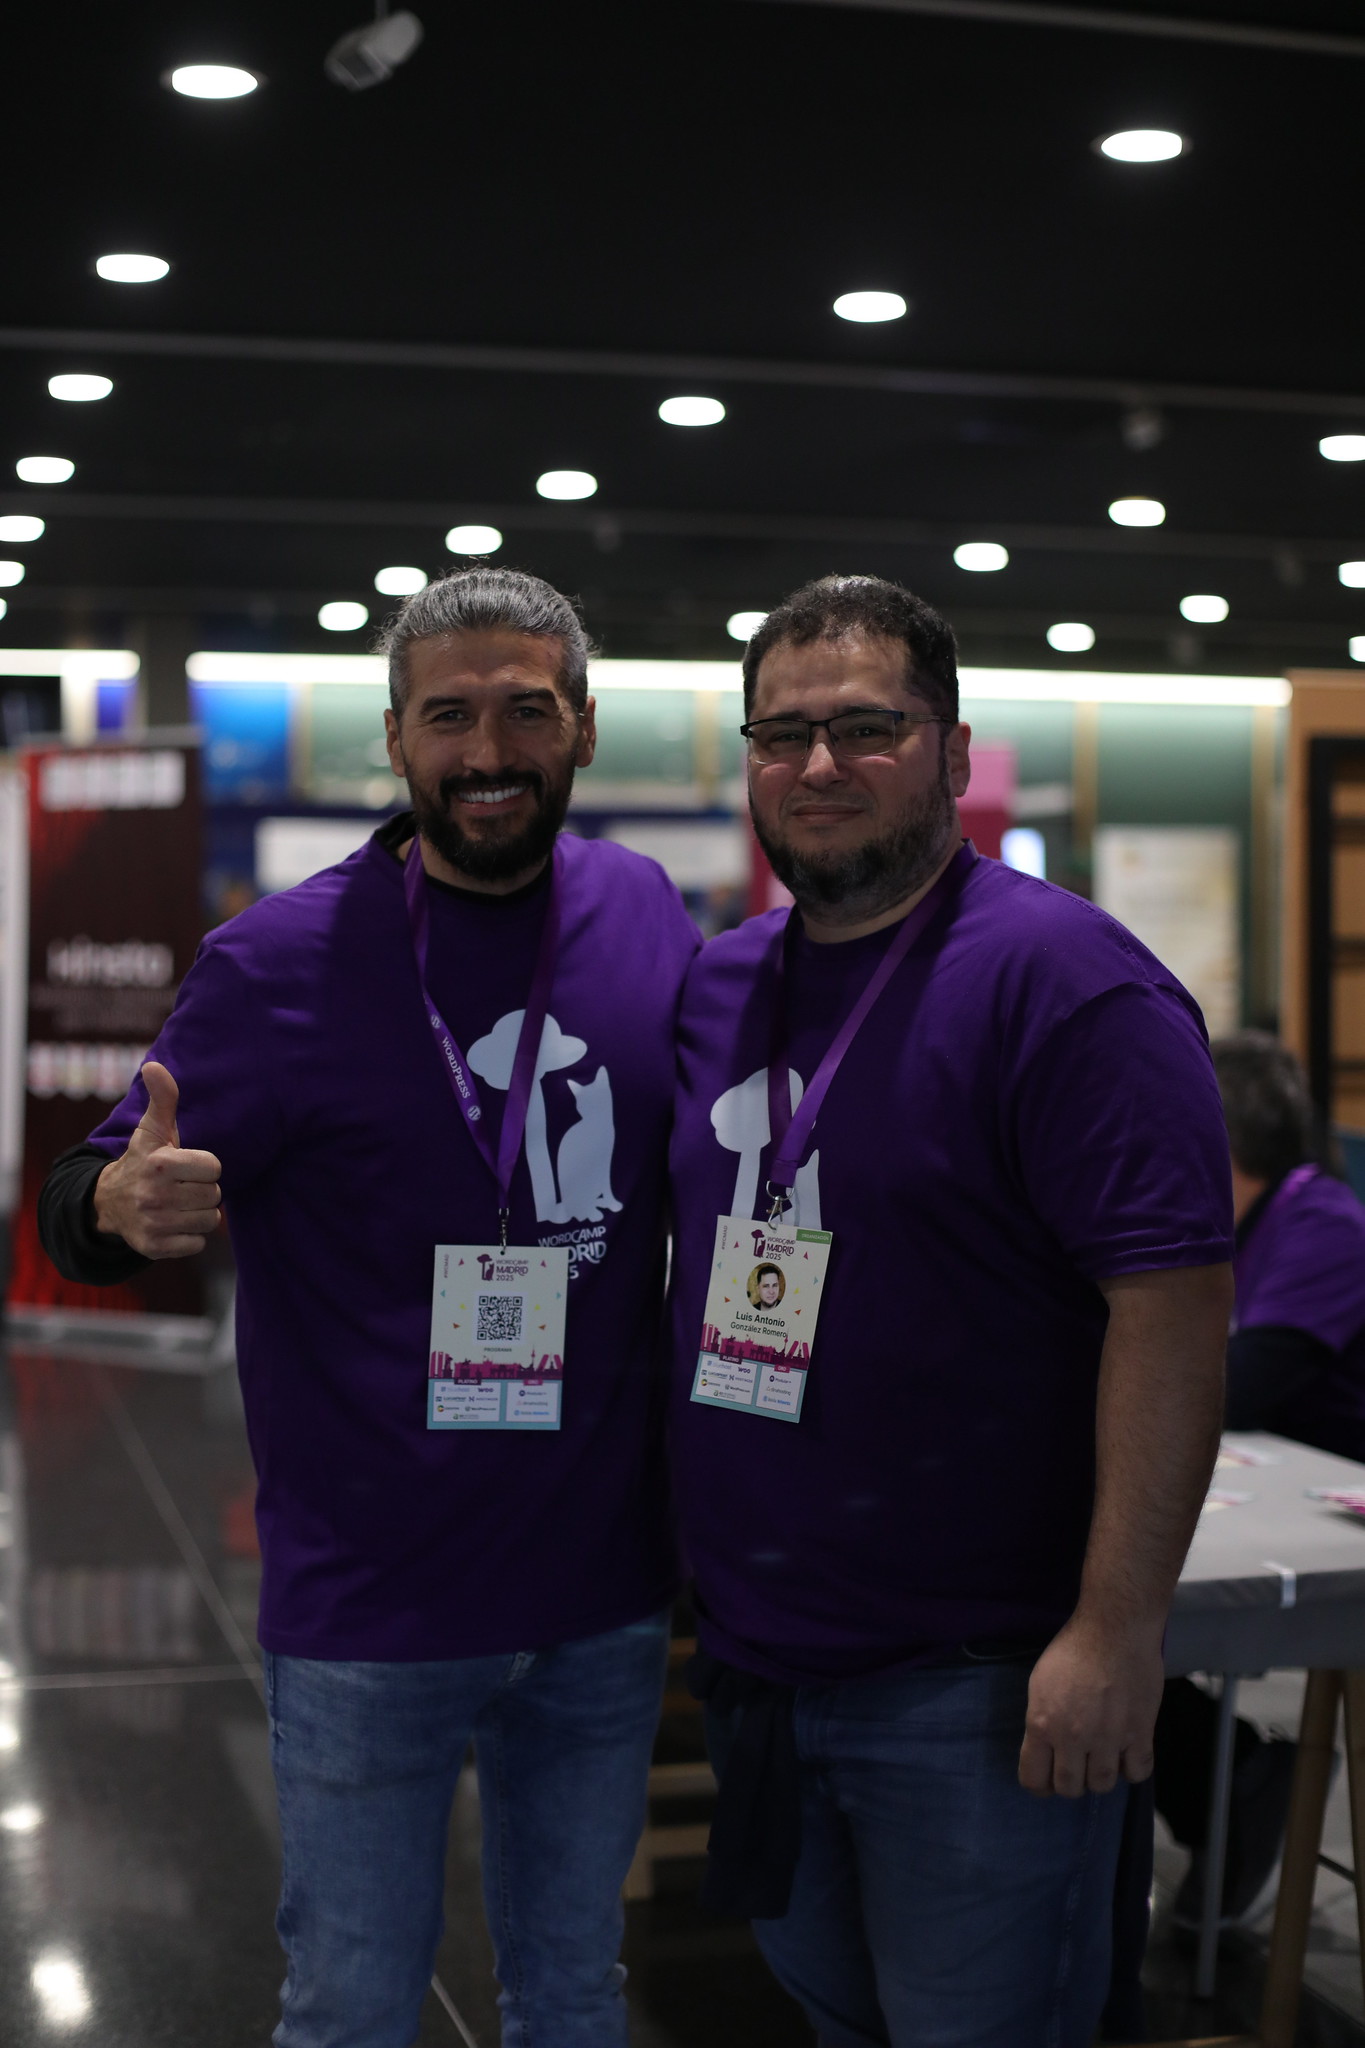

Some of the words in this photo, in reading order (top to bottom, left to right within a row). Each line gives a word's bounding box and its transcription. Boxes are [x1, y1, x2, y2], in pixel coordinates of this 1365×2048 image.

[537, 1225, 607, 1248] WORDCAMP
[567, 1241, 607, 1264] DRID
[765, 1252, 782, 1260] 2025
[766, 1243, 795, 1256] MADRID
[496, 1266, 529, 1276] MADRID
[735, 1311, 753, 1322] Luis
[754, 1314, 786, 1327] Antonio
[730, 1321, 761, 1334] González
[762, 1327, 788, 1338] Romero
